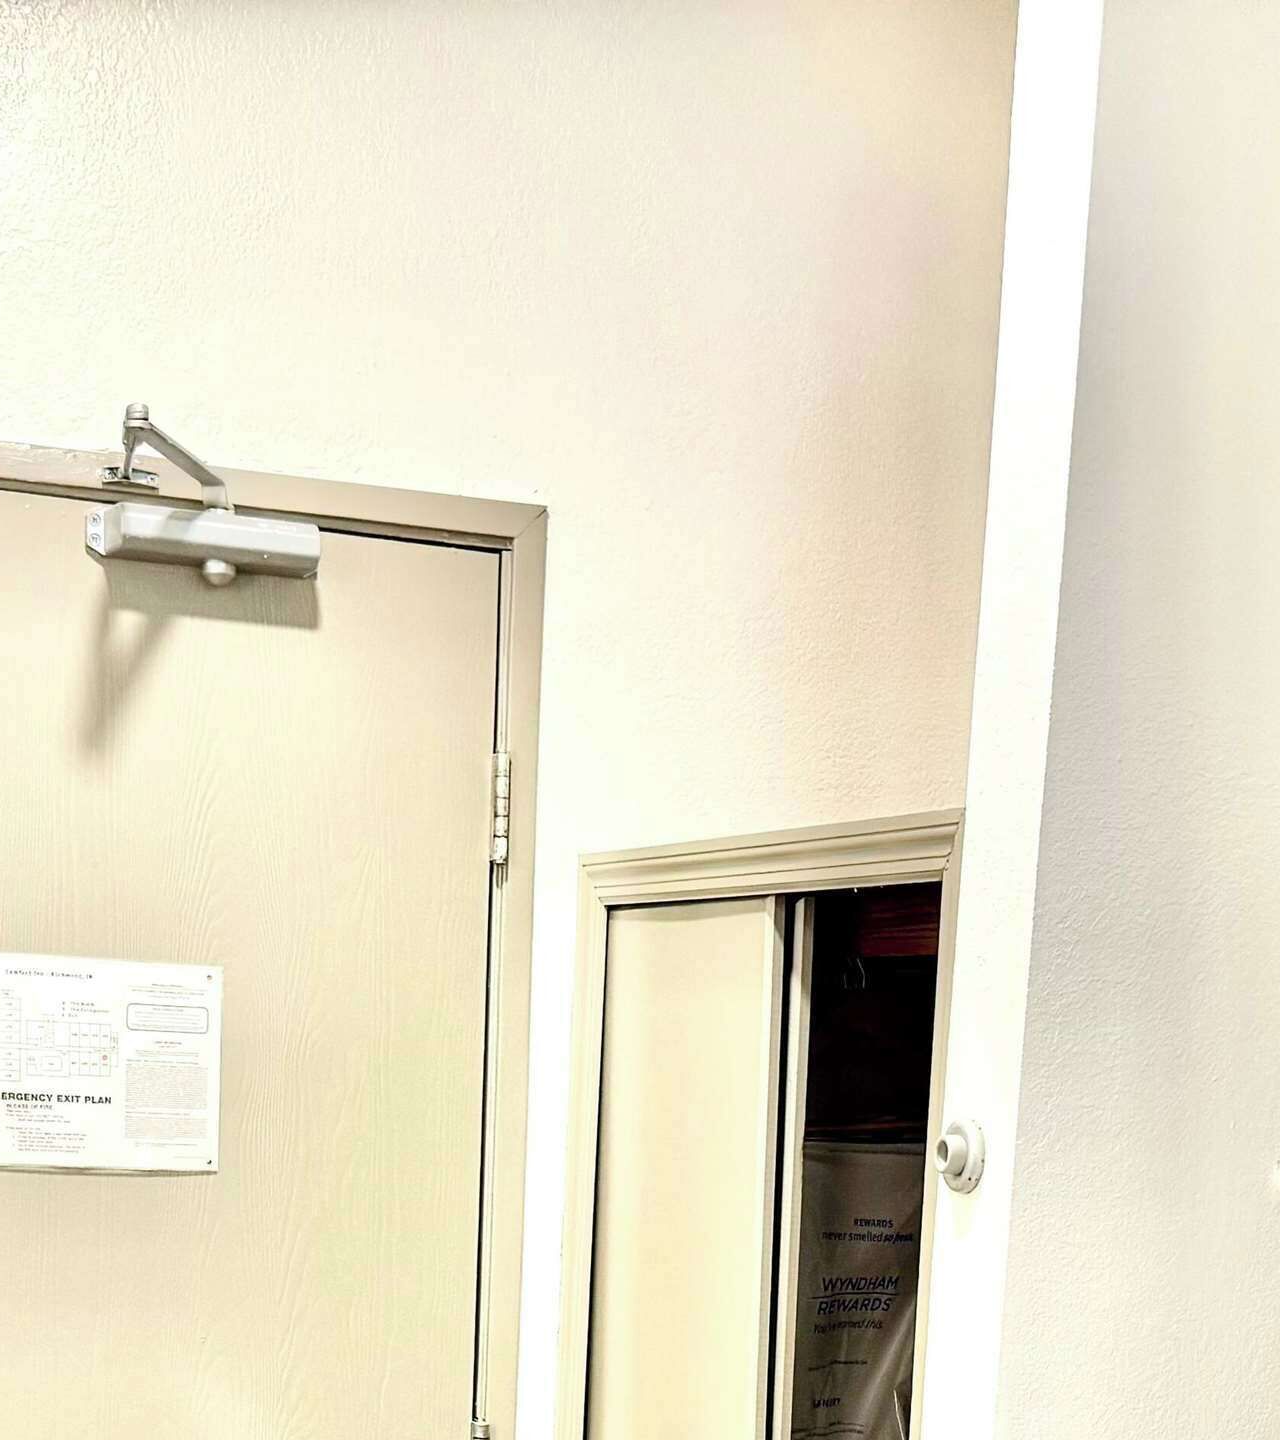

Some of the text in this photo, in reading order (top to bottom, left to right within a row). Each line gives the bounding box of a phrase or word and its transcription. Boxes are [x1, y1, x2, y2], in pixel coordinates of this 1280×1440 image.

[57, 1094, 81, 1103] EXIT
[84, 1096, 112, 1104] PLAN
[854, 1218, 894, 1228] REWARDS
[822, 1231, 849, 1241] never
[849, 1232, 882, 1242] smelled
[822, 1276, 900, 1292] WYNDHAM
[817, 1298, 893, 1315] REWARDS
